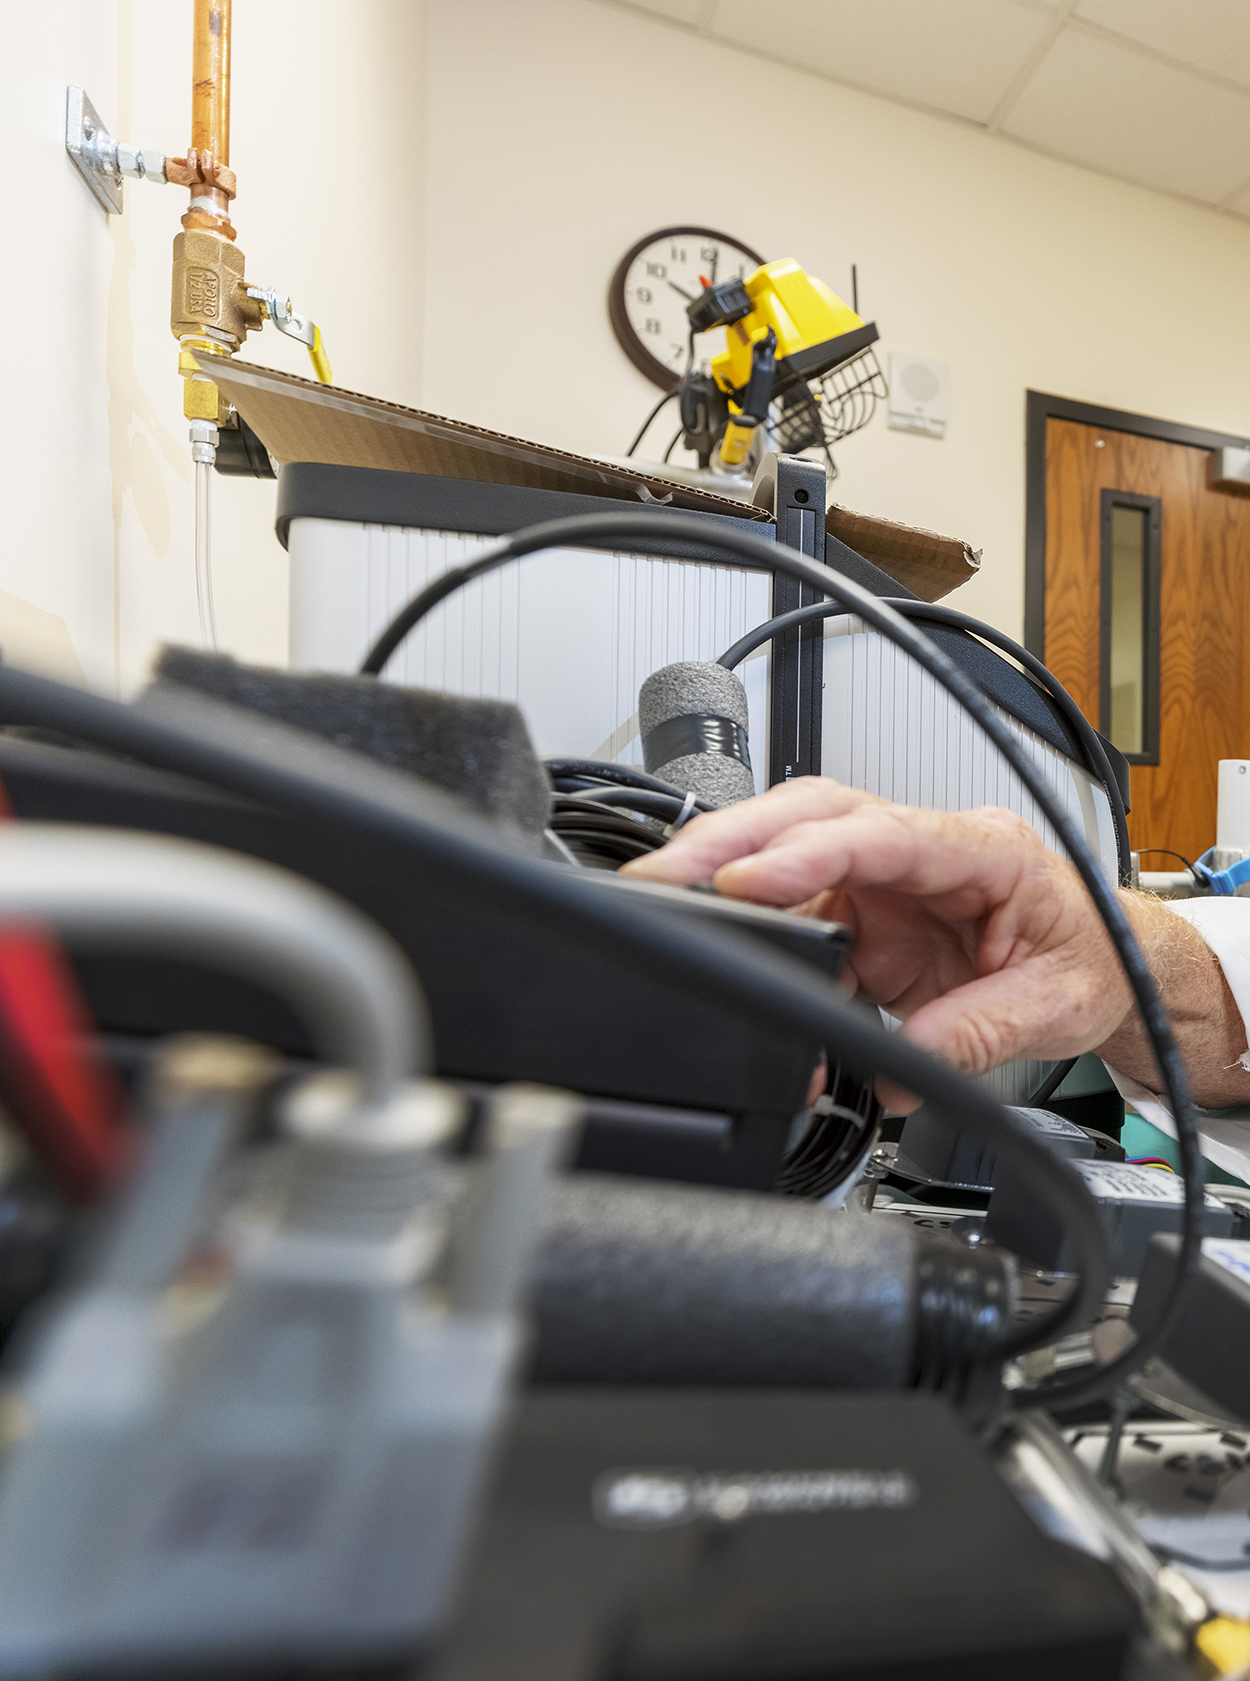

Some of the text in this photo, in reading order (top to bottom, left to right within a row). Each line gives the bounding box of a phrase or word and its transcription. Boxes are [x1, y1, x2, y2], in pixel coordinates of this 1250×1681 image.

[646, 262, 667, 278] 10
[203, 272, 217, 318] APOLLO
[636, 286, 652, 304] 9
[645, 317, 661, 334] 8
[669, 342, 685, 359] 7
[785, 765, 792, 776] TM
